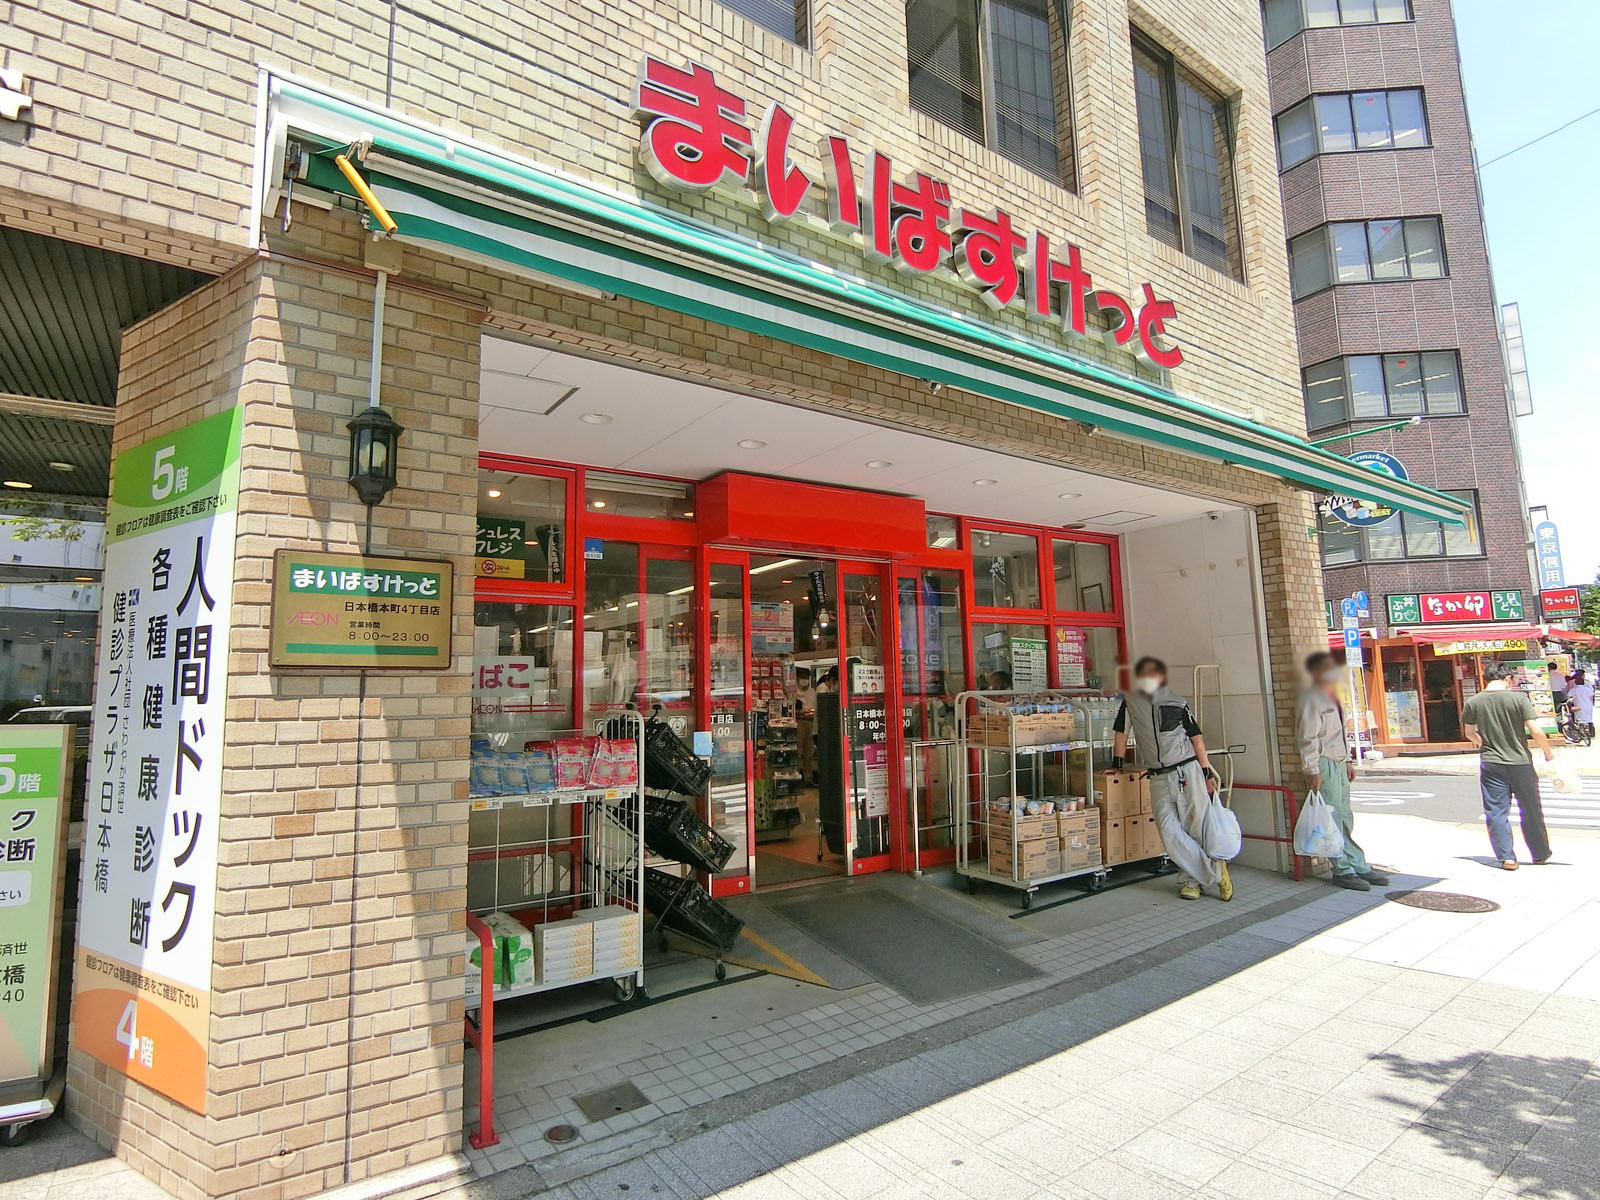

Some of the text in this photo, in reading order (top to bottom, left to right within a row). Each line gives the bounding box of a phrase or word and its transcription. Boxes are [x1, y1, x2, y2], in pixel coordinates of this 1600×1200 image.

[632, 54, 1184, 370] まいばすけっと
[151, 445, 189, 501] 5階
[293, 568, 438, 596] まいばすけっと
[344, 601, 441, 616] 日本橋本町4丁目店
[1427, 595, 1485, 616] なか卯
[349, 621, 381, 629] 営業時間
[1347, 630, 1358, 646] P
[472, 664, 530, 689] ばこ
[93, 591, 127, 895] 健診プラザ日本橋
[129, 547, 173, 950] 各種健康診断
[161, 535, 216, 953] 人間ドック
[0, 838, 36, 862] 断
[0, 963, 26, 986] 橋
[115, 999, 154, 1069] 4階
